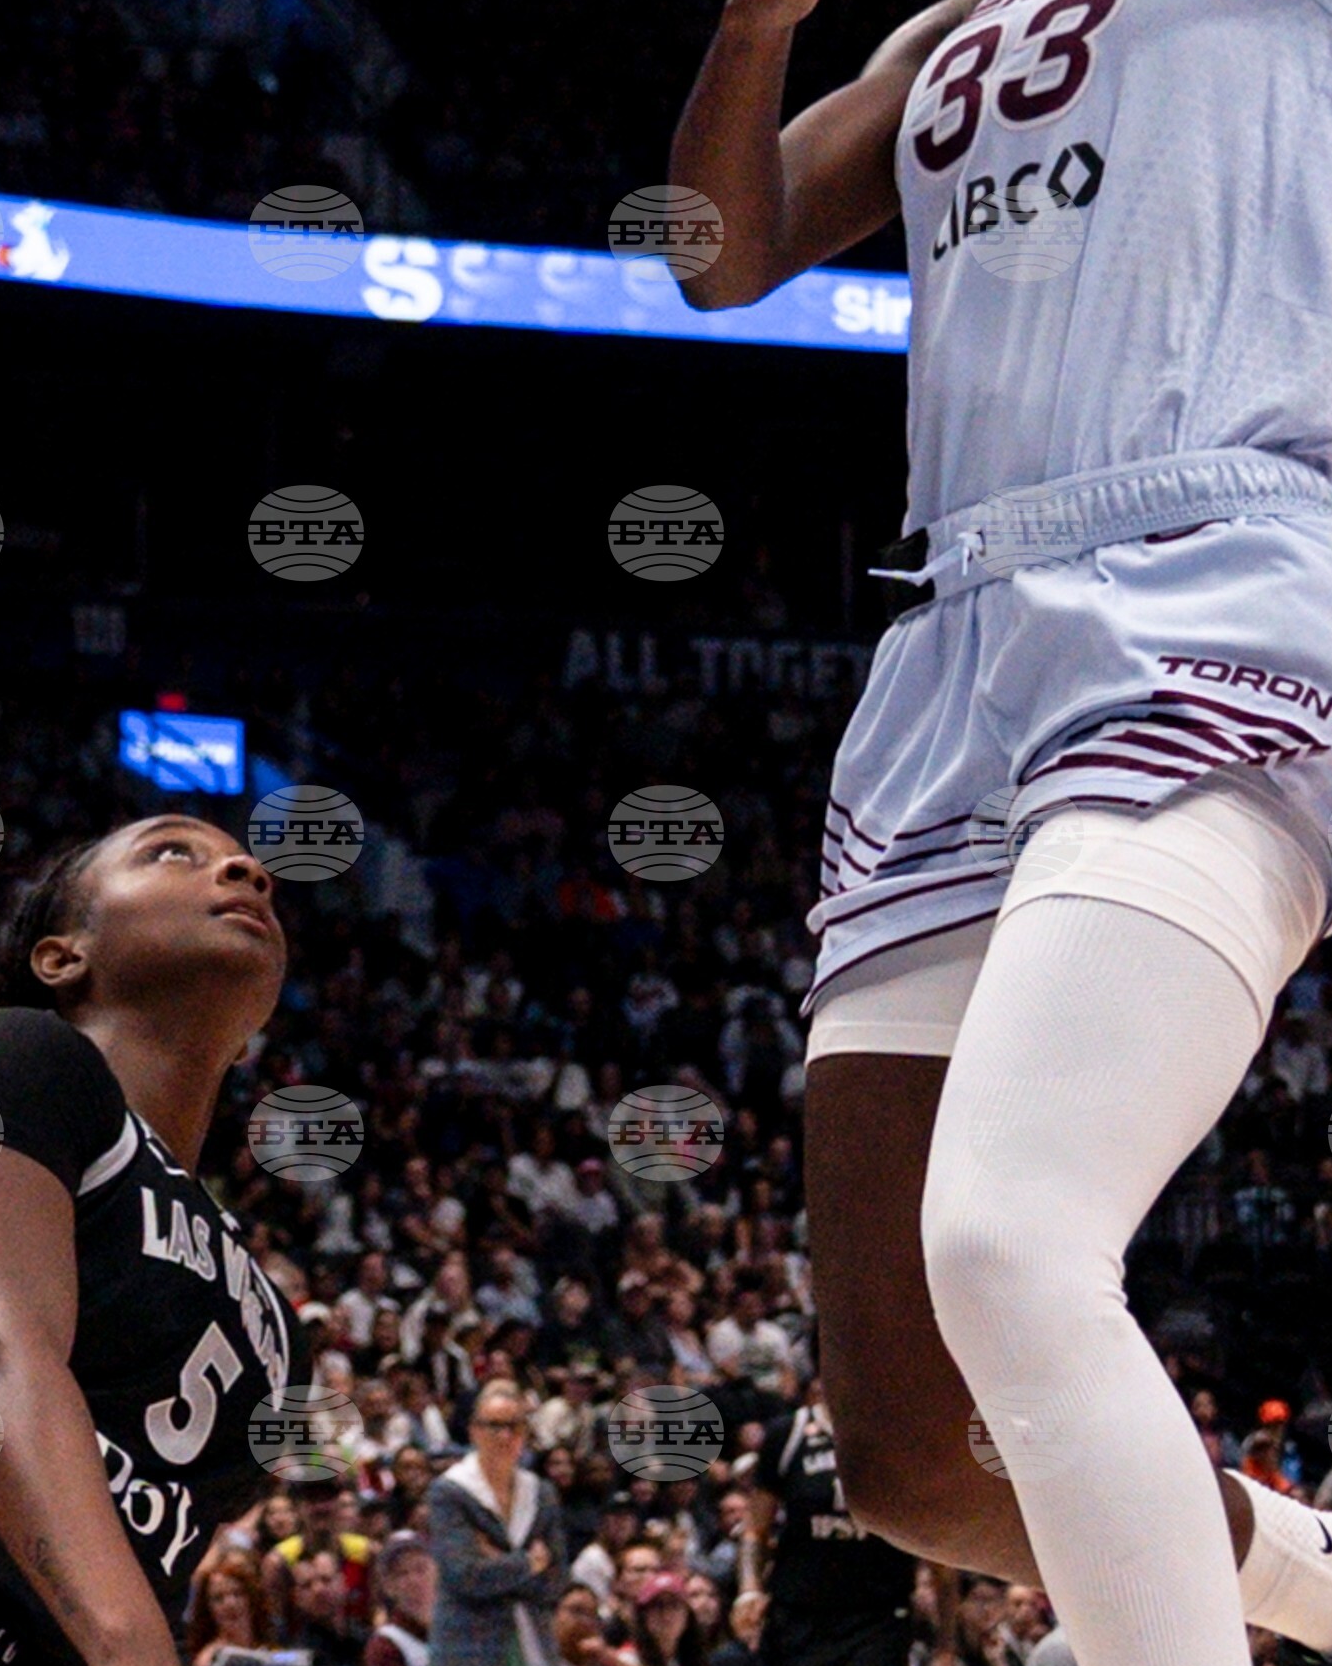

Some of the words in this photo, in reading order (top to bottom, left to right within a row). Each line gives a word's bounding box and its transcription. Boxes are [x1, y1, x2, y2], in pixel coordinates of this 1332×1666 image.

[559, 625, 673, 697] ALL
[139, 1185, 217, 1282] LAS
[143, 1320, 244, 1466] 5
